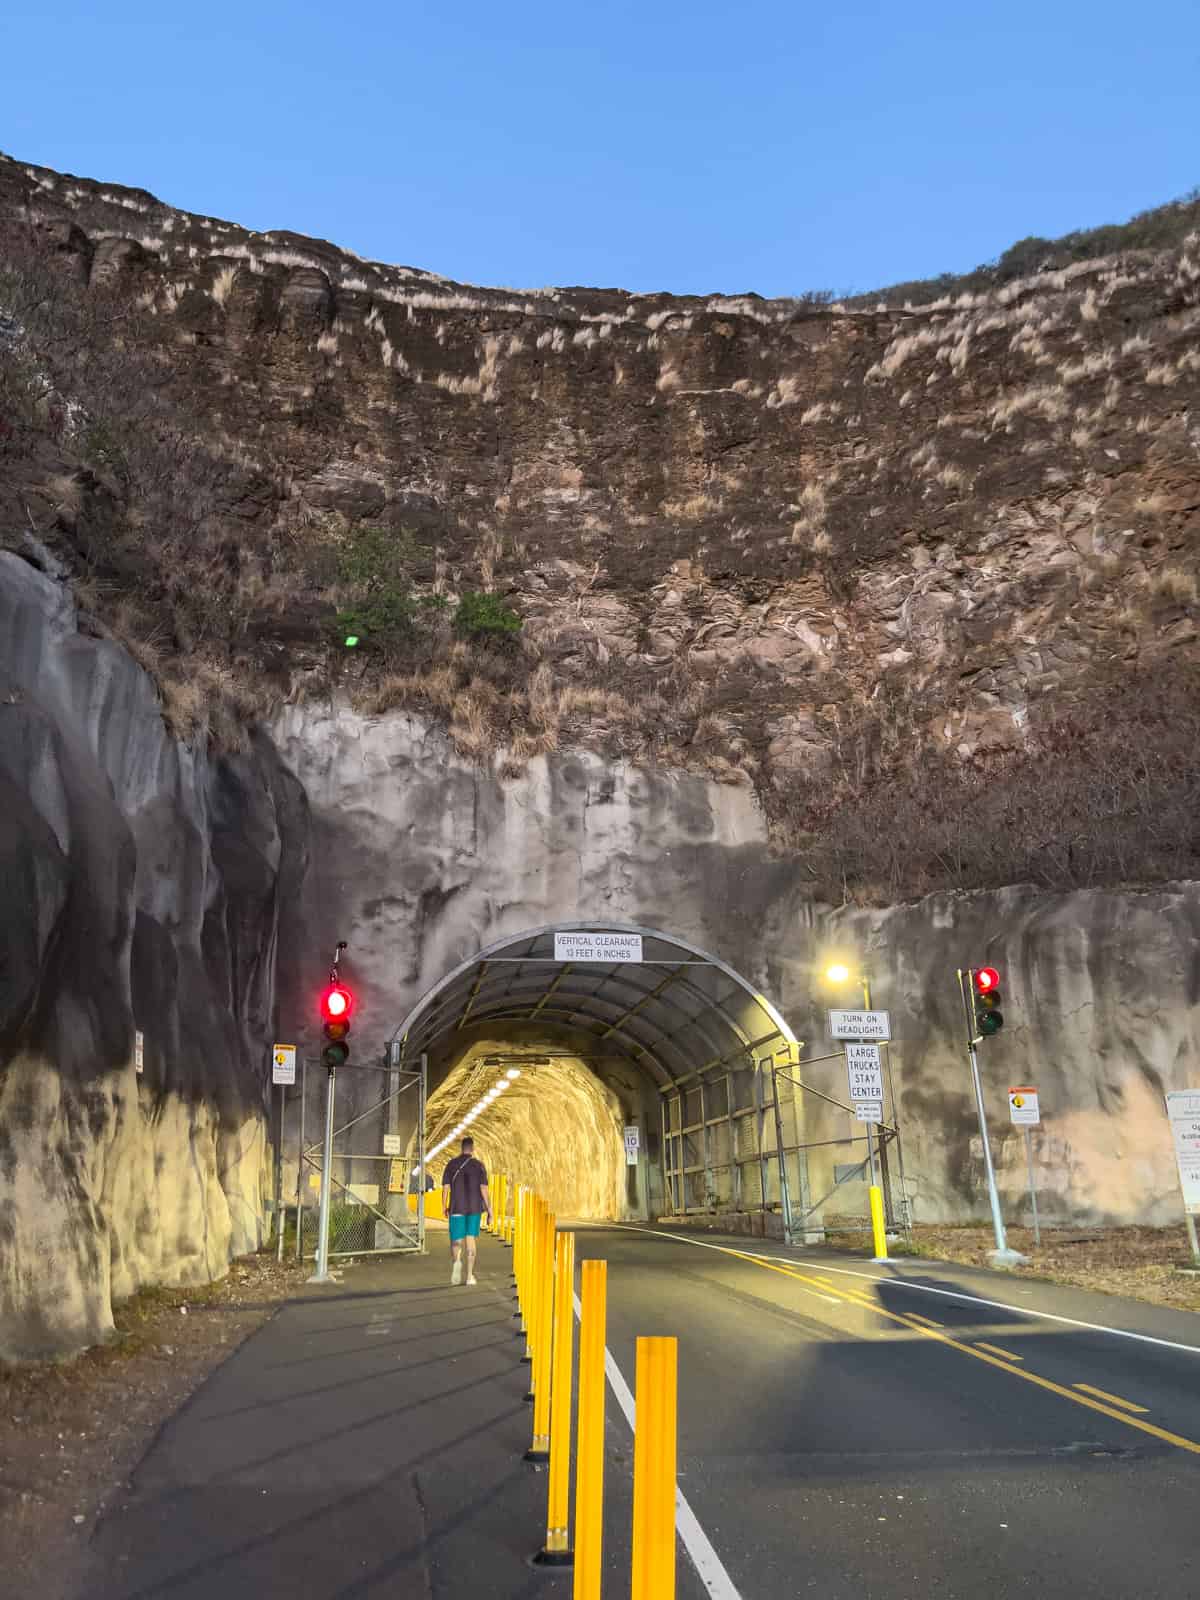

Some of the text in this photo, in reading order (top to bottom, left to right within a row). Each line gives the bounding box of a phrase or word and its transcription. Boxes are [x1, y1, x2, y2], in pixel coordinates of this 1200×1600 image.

[557, 936, 641, 946] VERTICAL CLEARANCE
[575, 949, 593, 957] FEET
[603, 950, 631, 959] INCHES
[842, 1015, 877, 1023] TURN ON
[837, 1025, 884, 1034] HEADLIGHTS
[850, 1048, 876, 1058] LARGE
[849, 1061, 880, 1071] TRUCKS
[855, 1074, 876, 1083] STAY
[852, 1087, 881, 1097] CENTER
[627, 1136, 637, 1146] 10
